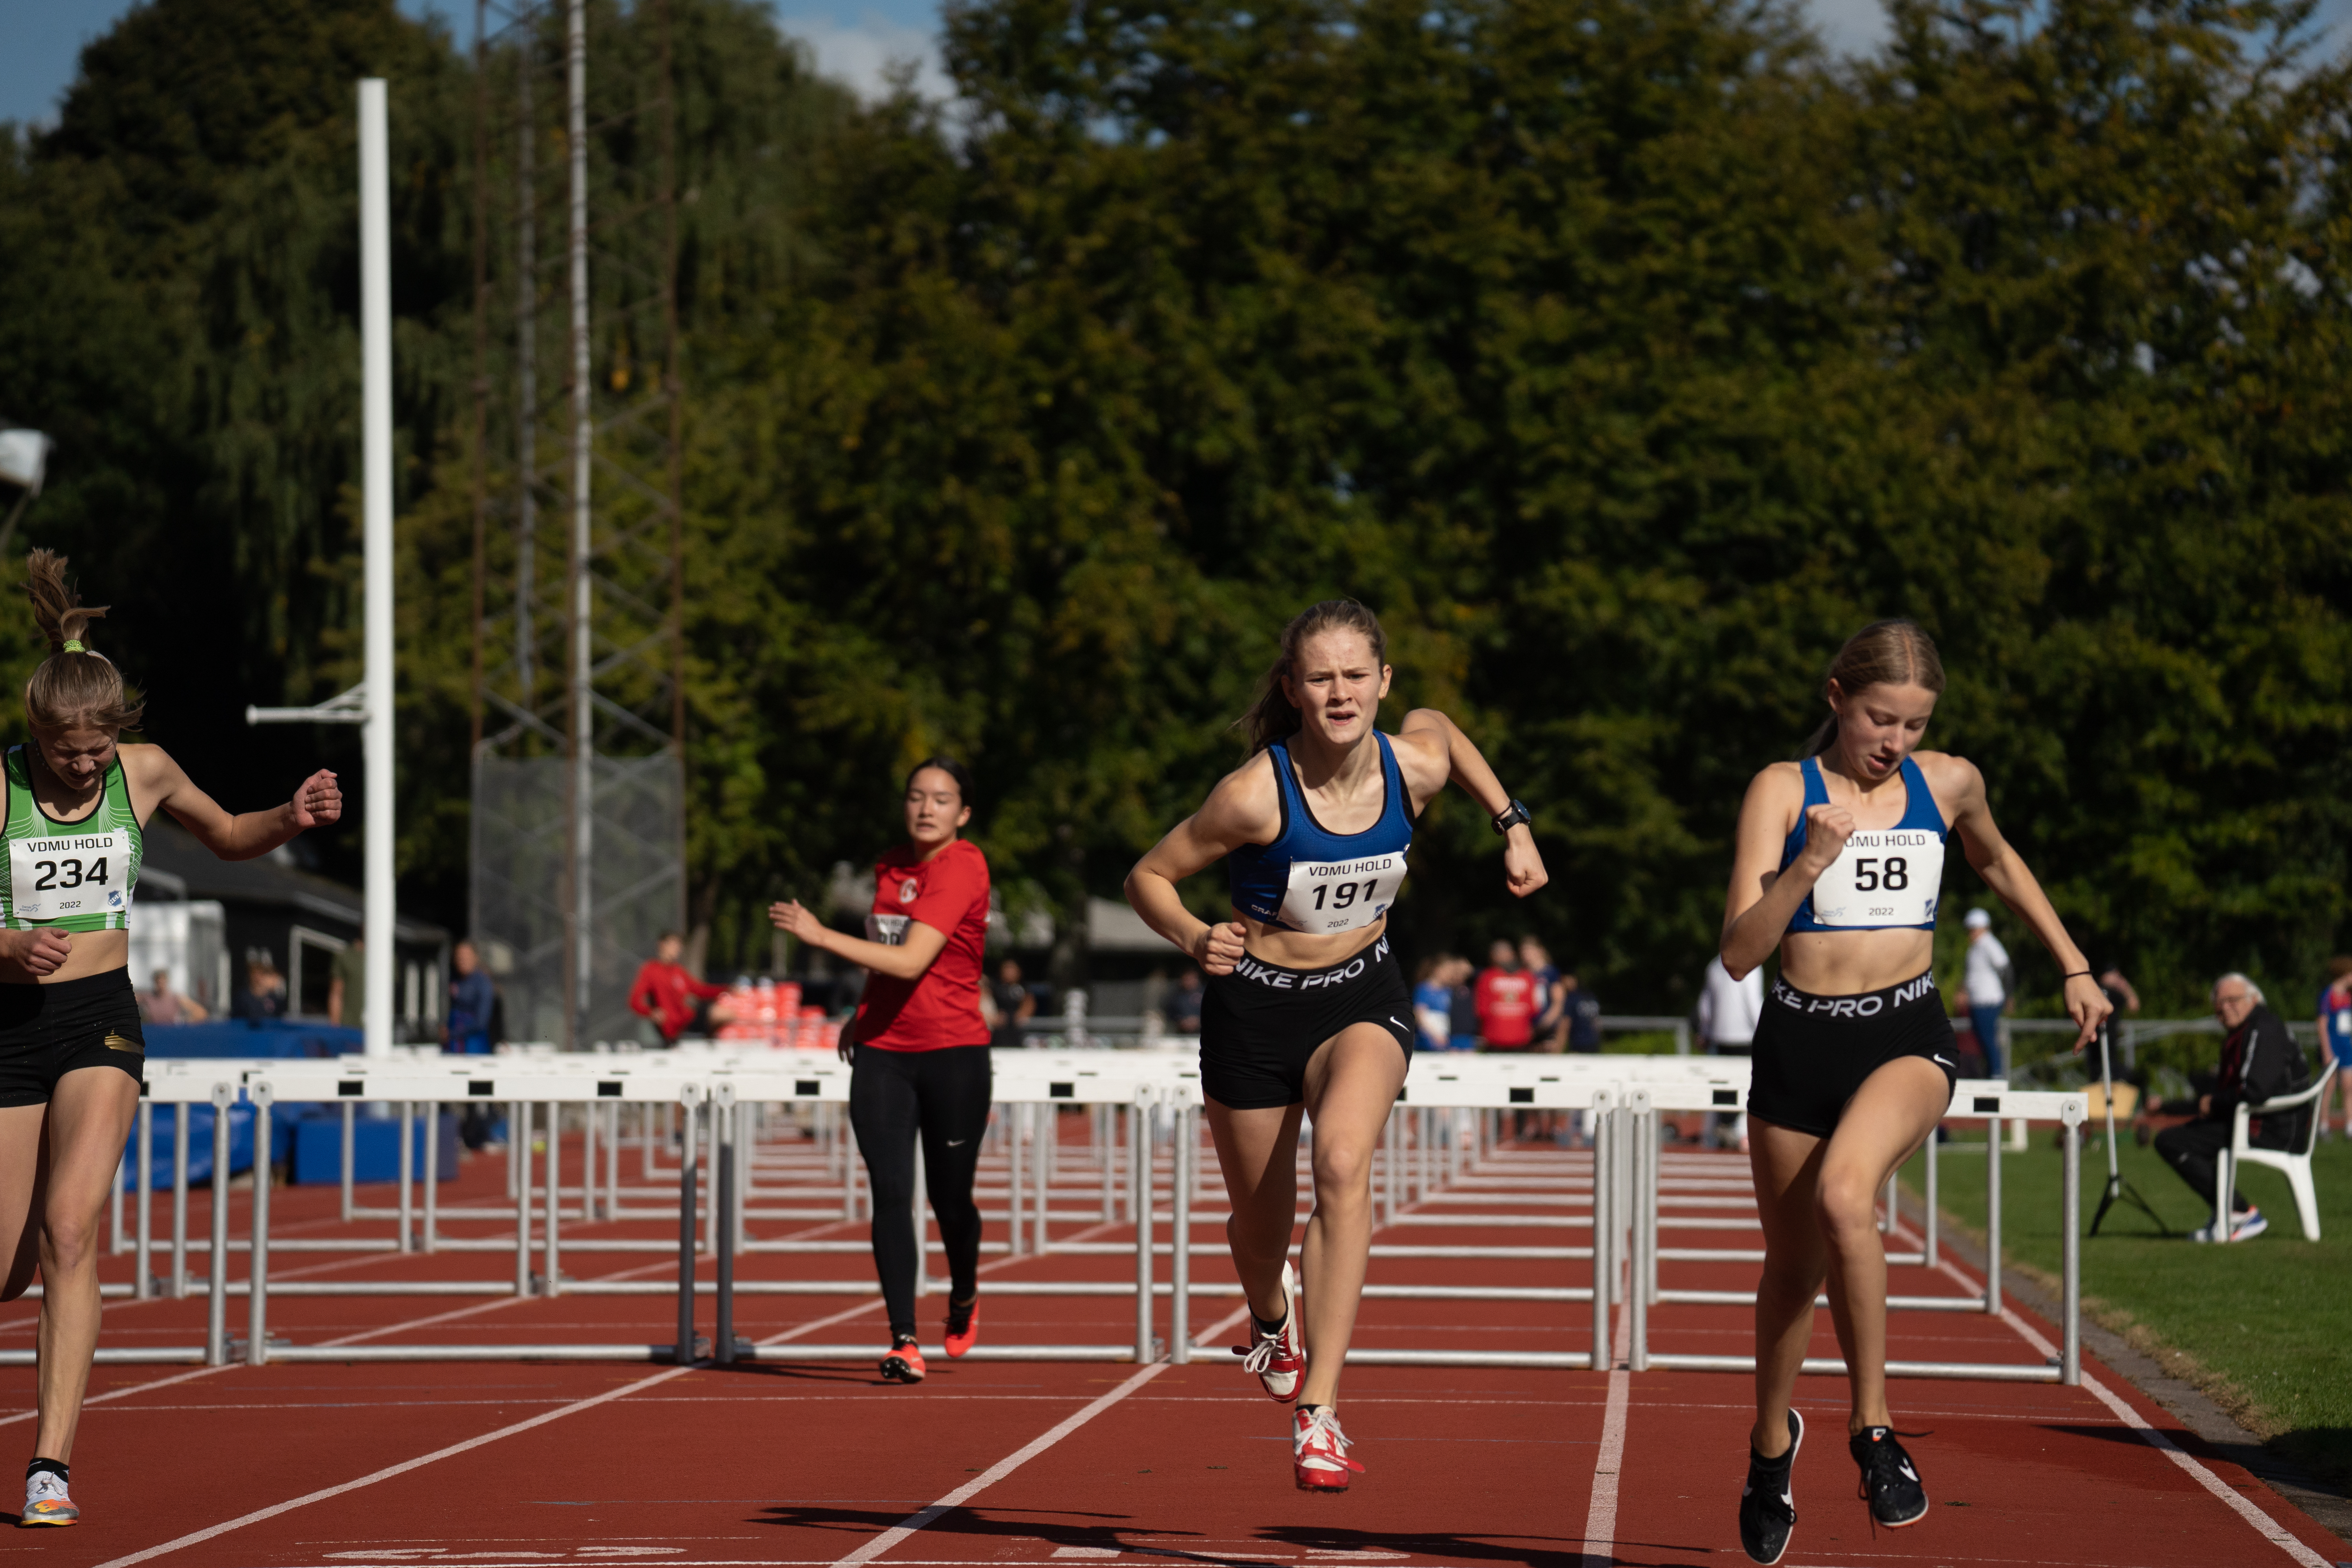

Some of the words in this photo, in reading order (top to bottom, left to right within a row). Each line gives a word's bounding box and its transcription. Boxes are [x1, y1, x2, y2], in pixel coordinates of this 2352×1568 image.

[27, 840, 70, 853] VDMU
[74, 837, 113, 850] HOLD
[1845, 835, 1880, 847] DMU
[1886, 835, 1926, 846] HOLD
[35, 857, 109, 891] 234
[1309, 865, 1351, 876] VDMU
[1355, 858, 1392, 873] HOLD
[1855, 857, 1908, 891] 58
[109, 893, 121, 905] HGF
[1312, 879, 1379, 911] 191
[60, 901, 81, 909] 2022
[1251, 904, 1278, 916] CRAF
[1868, 907, 1894, 916] 2022
[1327, 918, 1349, 928] 2022
[1300, 958, 1365, 990] PRO
[1375, 932, 1389, 962] NI
[1771, 979, 1802, 1009] KE
[1807, 995, 1883, 1018] PRO
